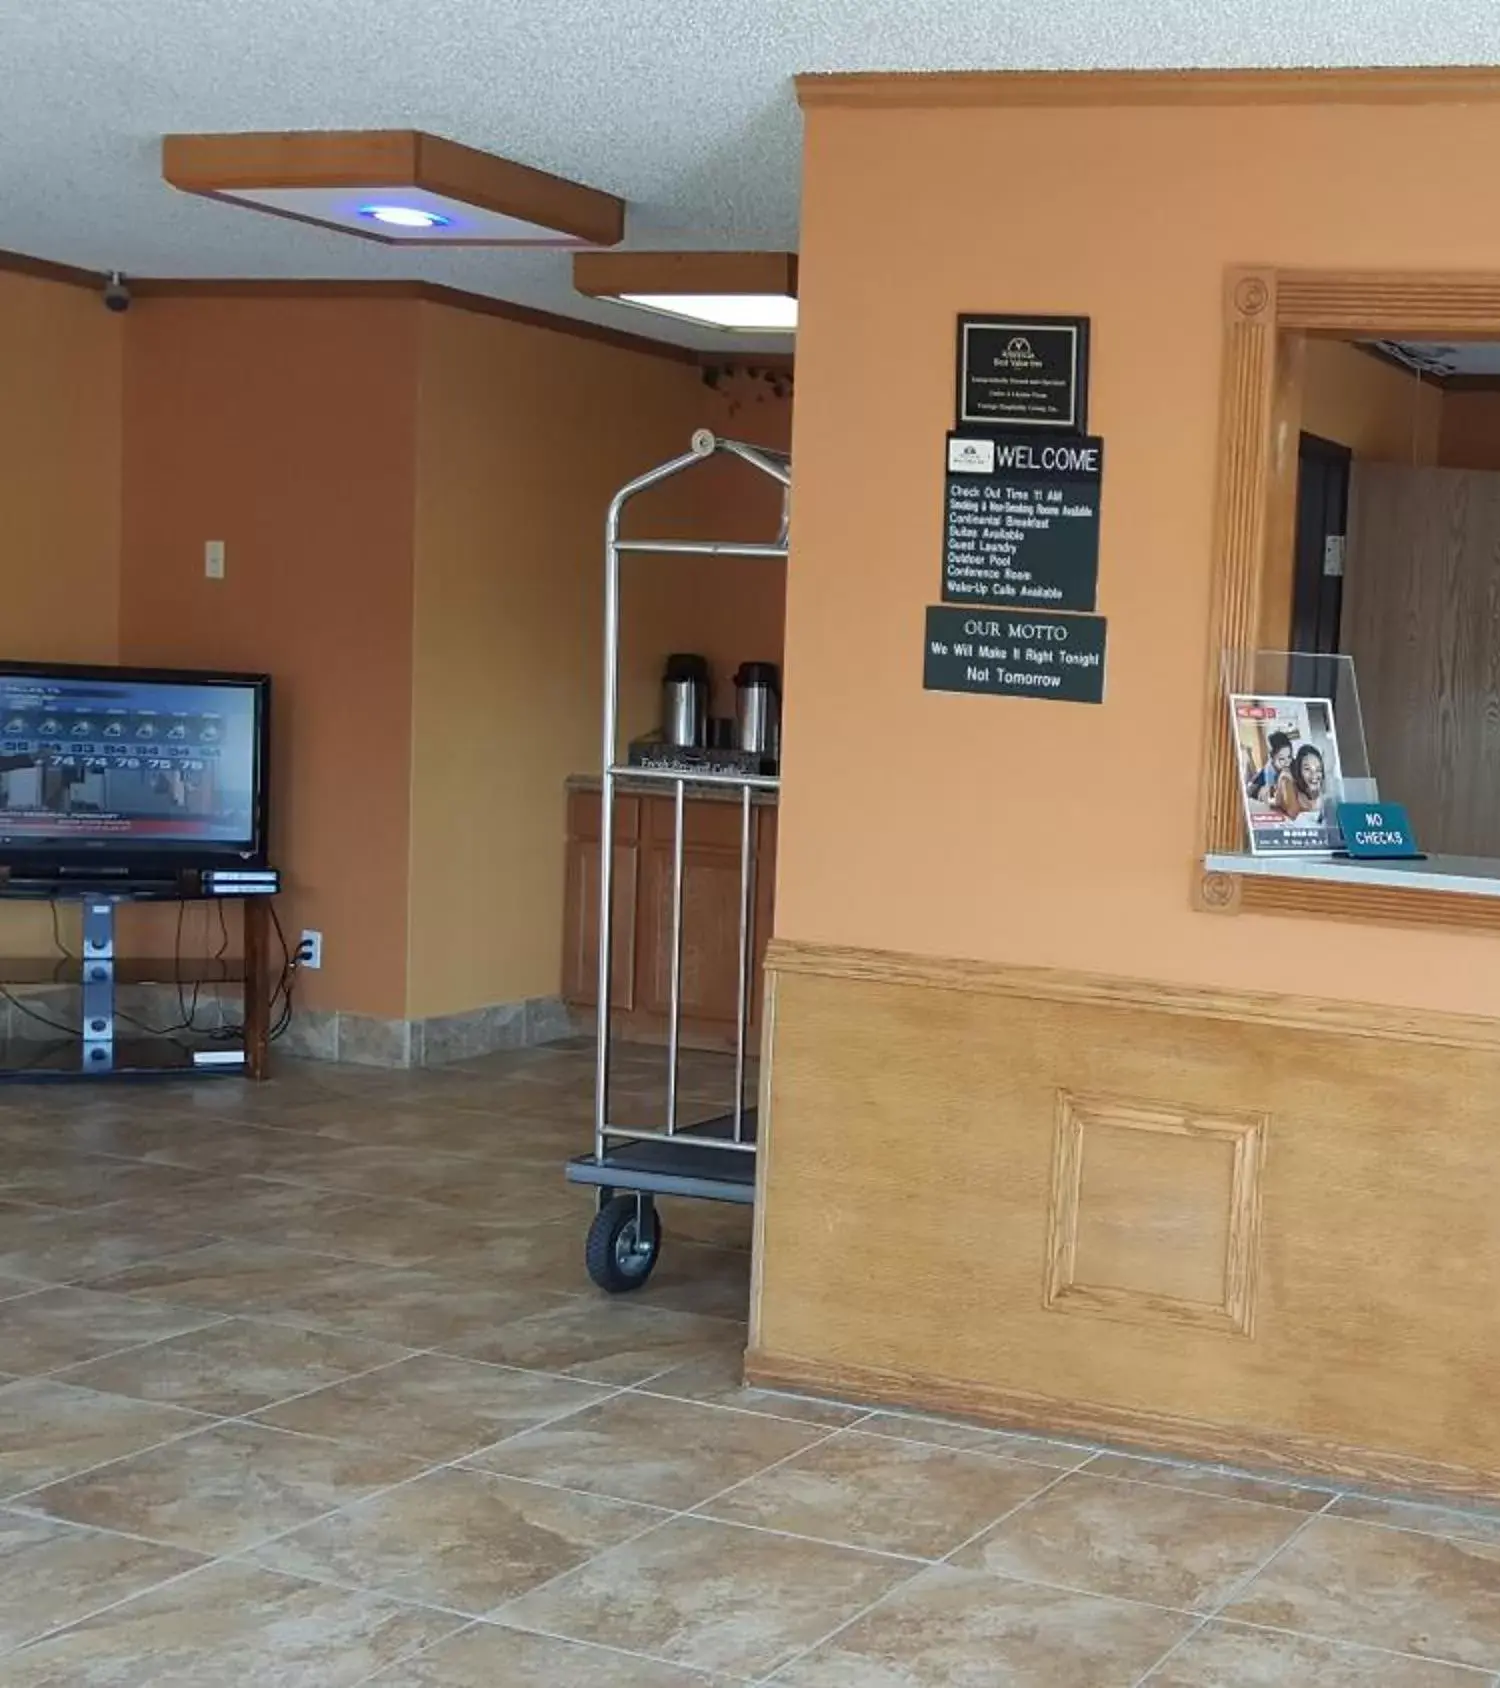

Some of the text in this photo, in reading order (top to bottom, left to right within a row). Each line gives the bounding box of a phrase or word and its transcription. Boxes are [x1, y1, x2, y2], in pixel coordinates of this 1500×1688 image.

[996, 445, 1099, 472] WELCOME
[950, 485, 980, 498] Check
[984, 486, 1001, 499] Out
[1006, 487, 1029, 500] Time
[1047, 488, 1063, 501] AM
[950, 511, 1050, 529] Continental Breakfast
[982, 528, 1025, 541] Available
[949, 538, 1017, 555] Guest Laundry
[948, 551, 1011, 567] Outdoor Pool
[947, 565, 1032, 581] Conference Room
[992, 583, 1016, 597] Calls
[1020, 585, 1063, 599] Available
[964, 619, 1069, 641] OUR MOTTO
[931, 641, 1099, 668] We Will Make It Right Tonight
[966, 665, 1061, 688] Not Tomorrow
[1365, 812, 1383, 827] NO
[1354, 831, 1403, 845] CHECKS
